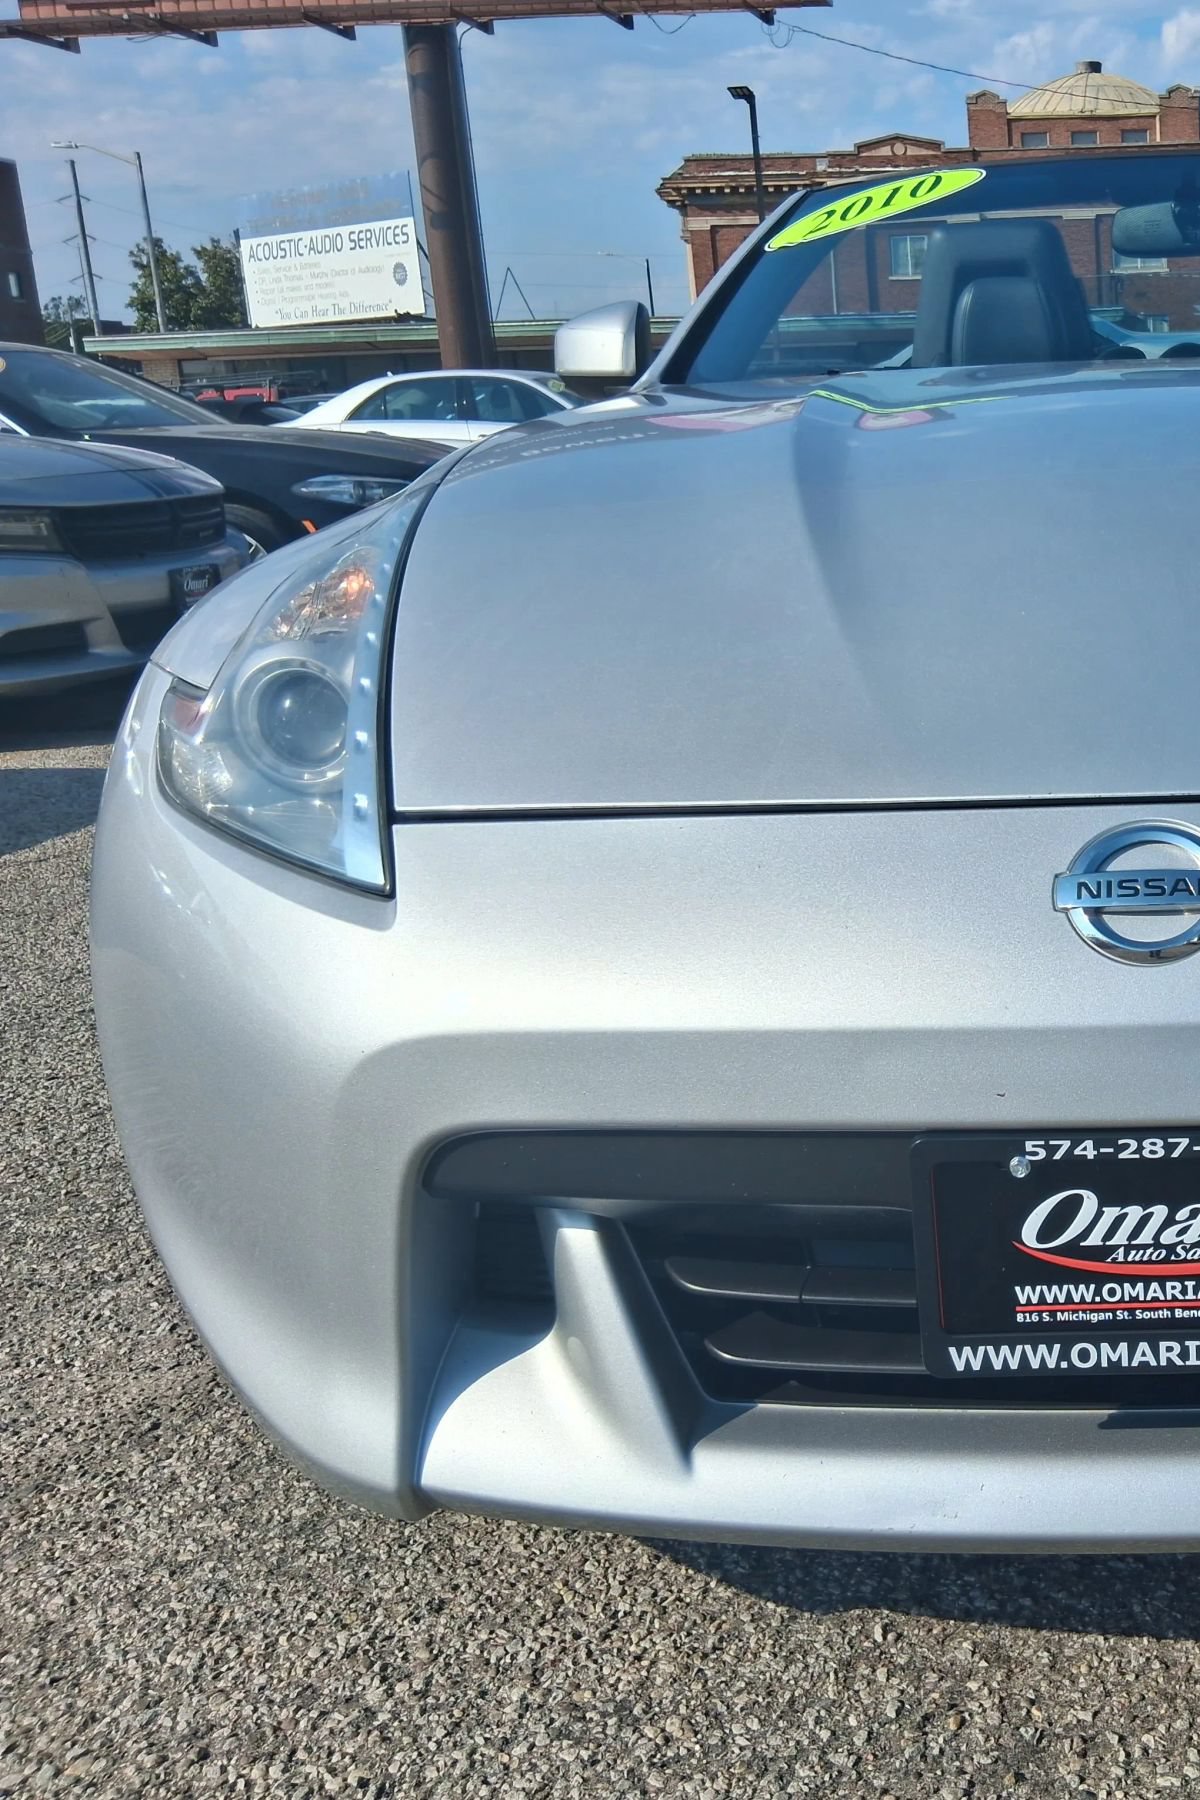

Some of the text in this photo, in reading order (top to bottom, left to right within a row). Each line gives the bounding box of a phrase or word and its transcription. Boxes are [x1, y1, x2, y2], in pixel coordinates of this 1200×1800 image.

[803, 174, 943, 238] 2010
[348, 223, 410, 251] SERVICES
[294, 307, 308, 320] Can
[311, 305, 328, 317] Hear
[331, 303, 346, 315] The
[1106, 1244, 1167, 1262] Auto
[1016, 1311, 1039, 1323] 816
[1042, 1311, 1054, 1322] S.
[1057, 1310, 1113, 1324] Michigan
[1116, 1309, 1132, 1320] St.
[1136, 1308, 1171, 1320] South
